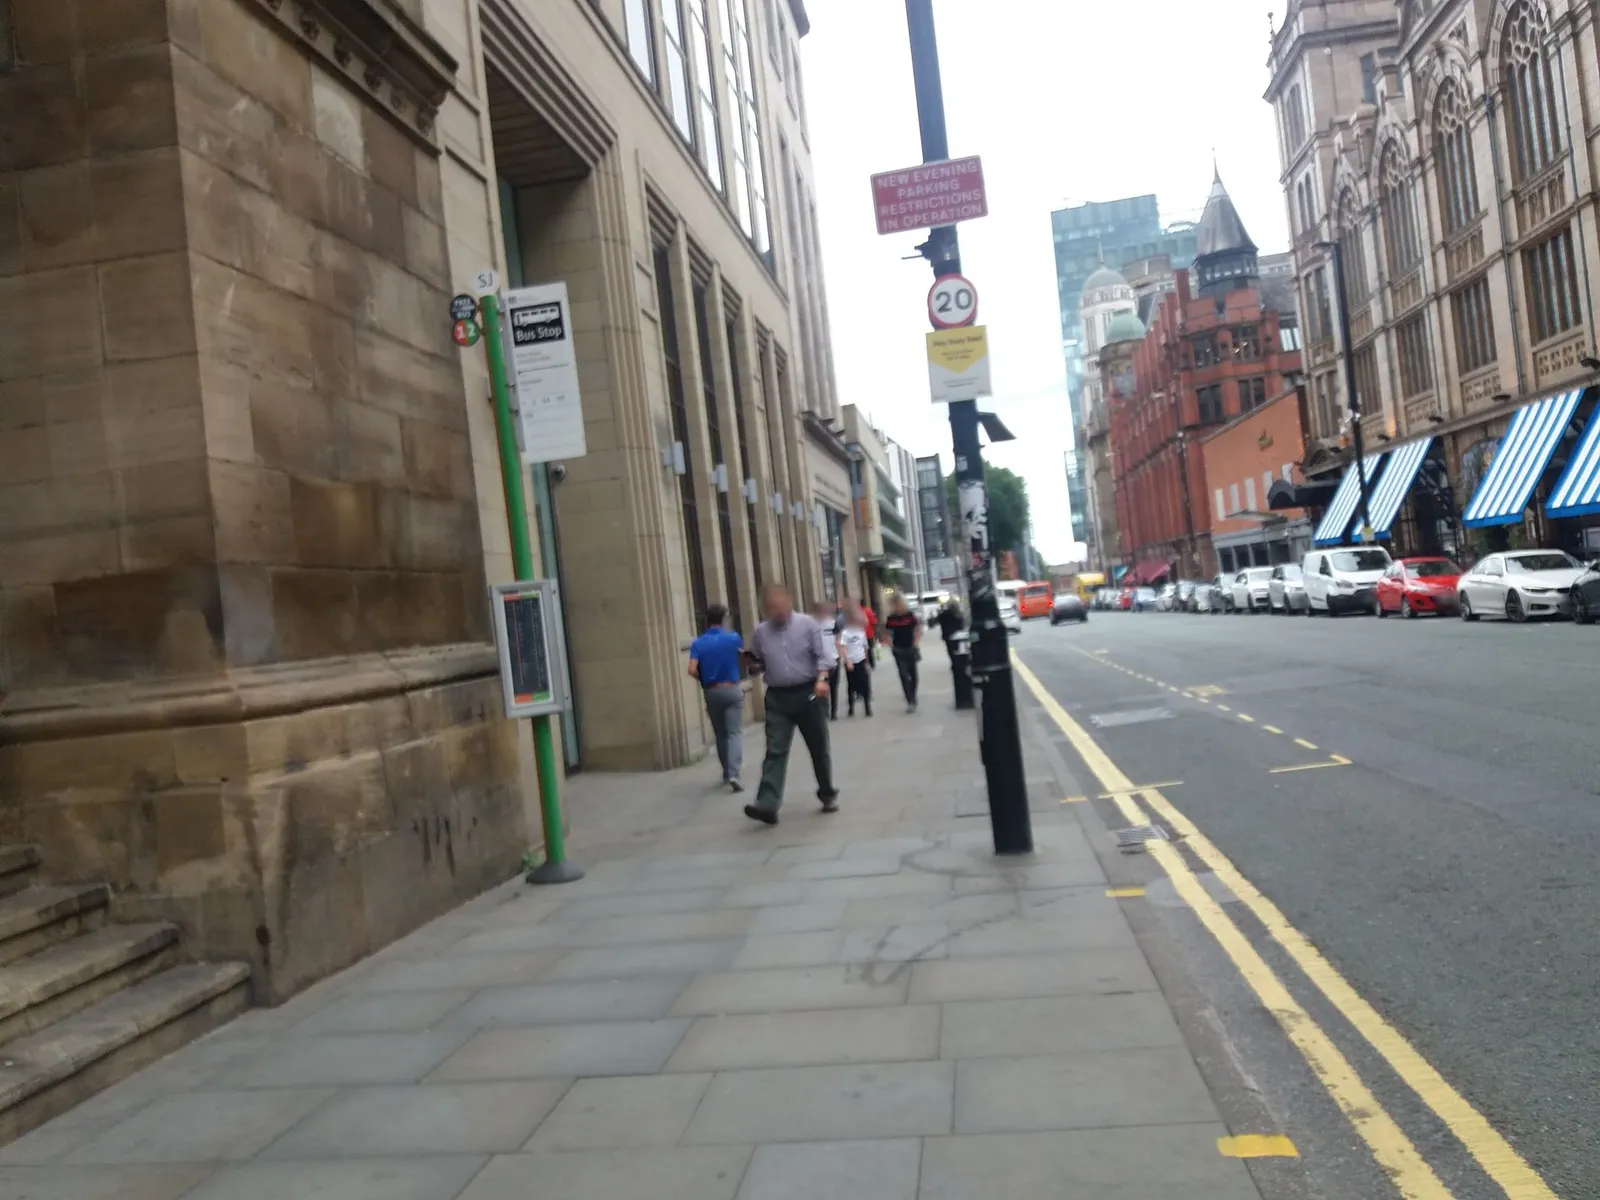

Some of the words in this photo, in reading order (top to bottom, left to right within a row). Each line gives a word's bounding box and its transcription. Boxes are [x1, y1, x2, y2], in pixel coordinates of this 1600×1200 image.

[878, 173, 909, 188] NEW
[914, 161, 977, 182] EVENING
[897, 180, 961, 199] PARKING
[881, 189, 981, 217] RESTRICTIONS
[883, 217, 899, 231] IN
[903, 204, 982, 227] OPERATION
[478, 272, 494, 288] SJ
[935, 288, 973, 313] 20
[515, 329, 537, 342] Bus
[536, 325, 562, 340] Stop
